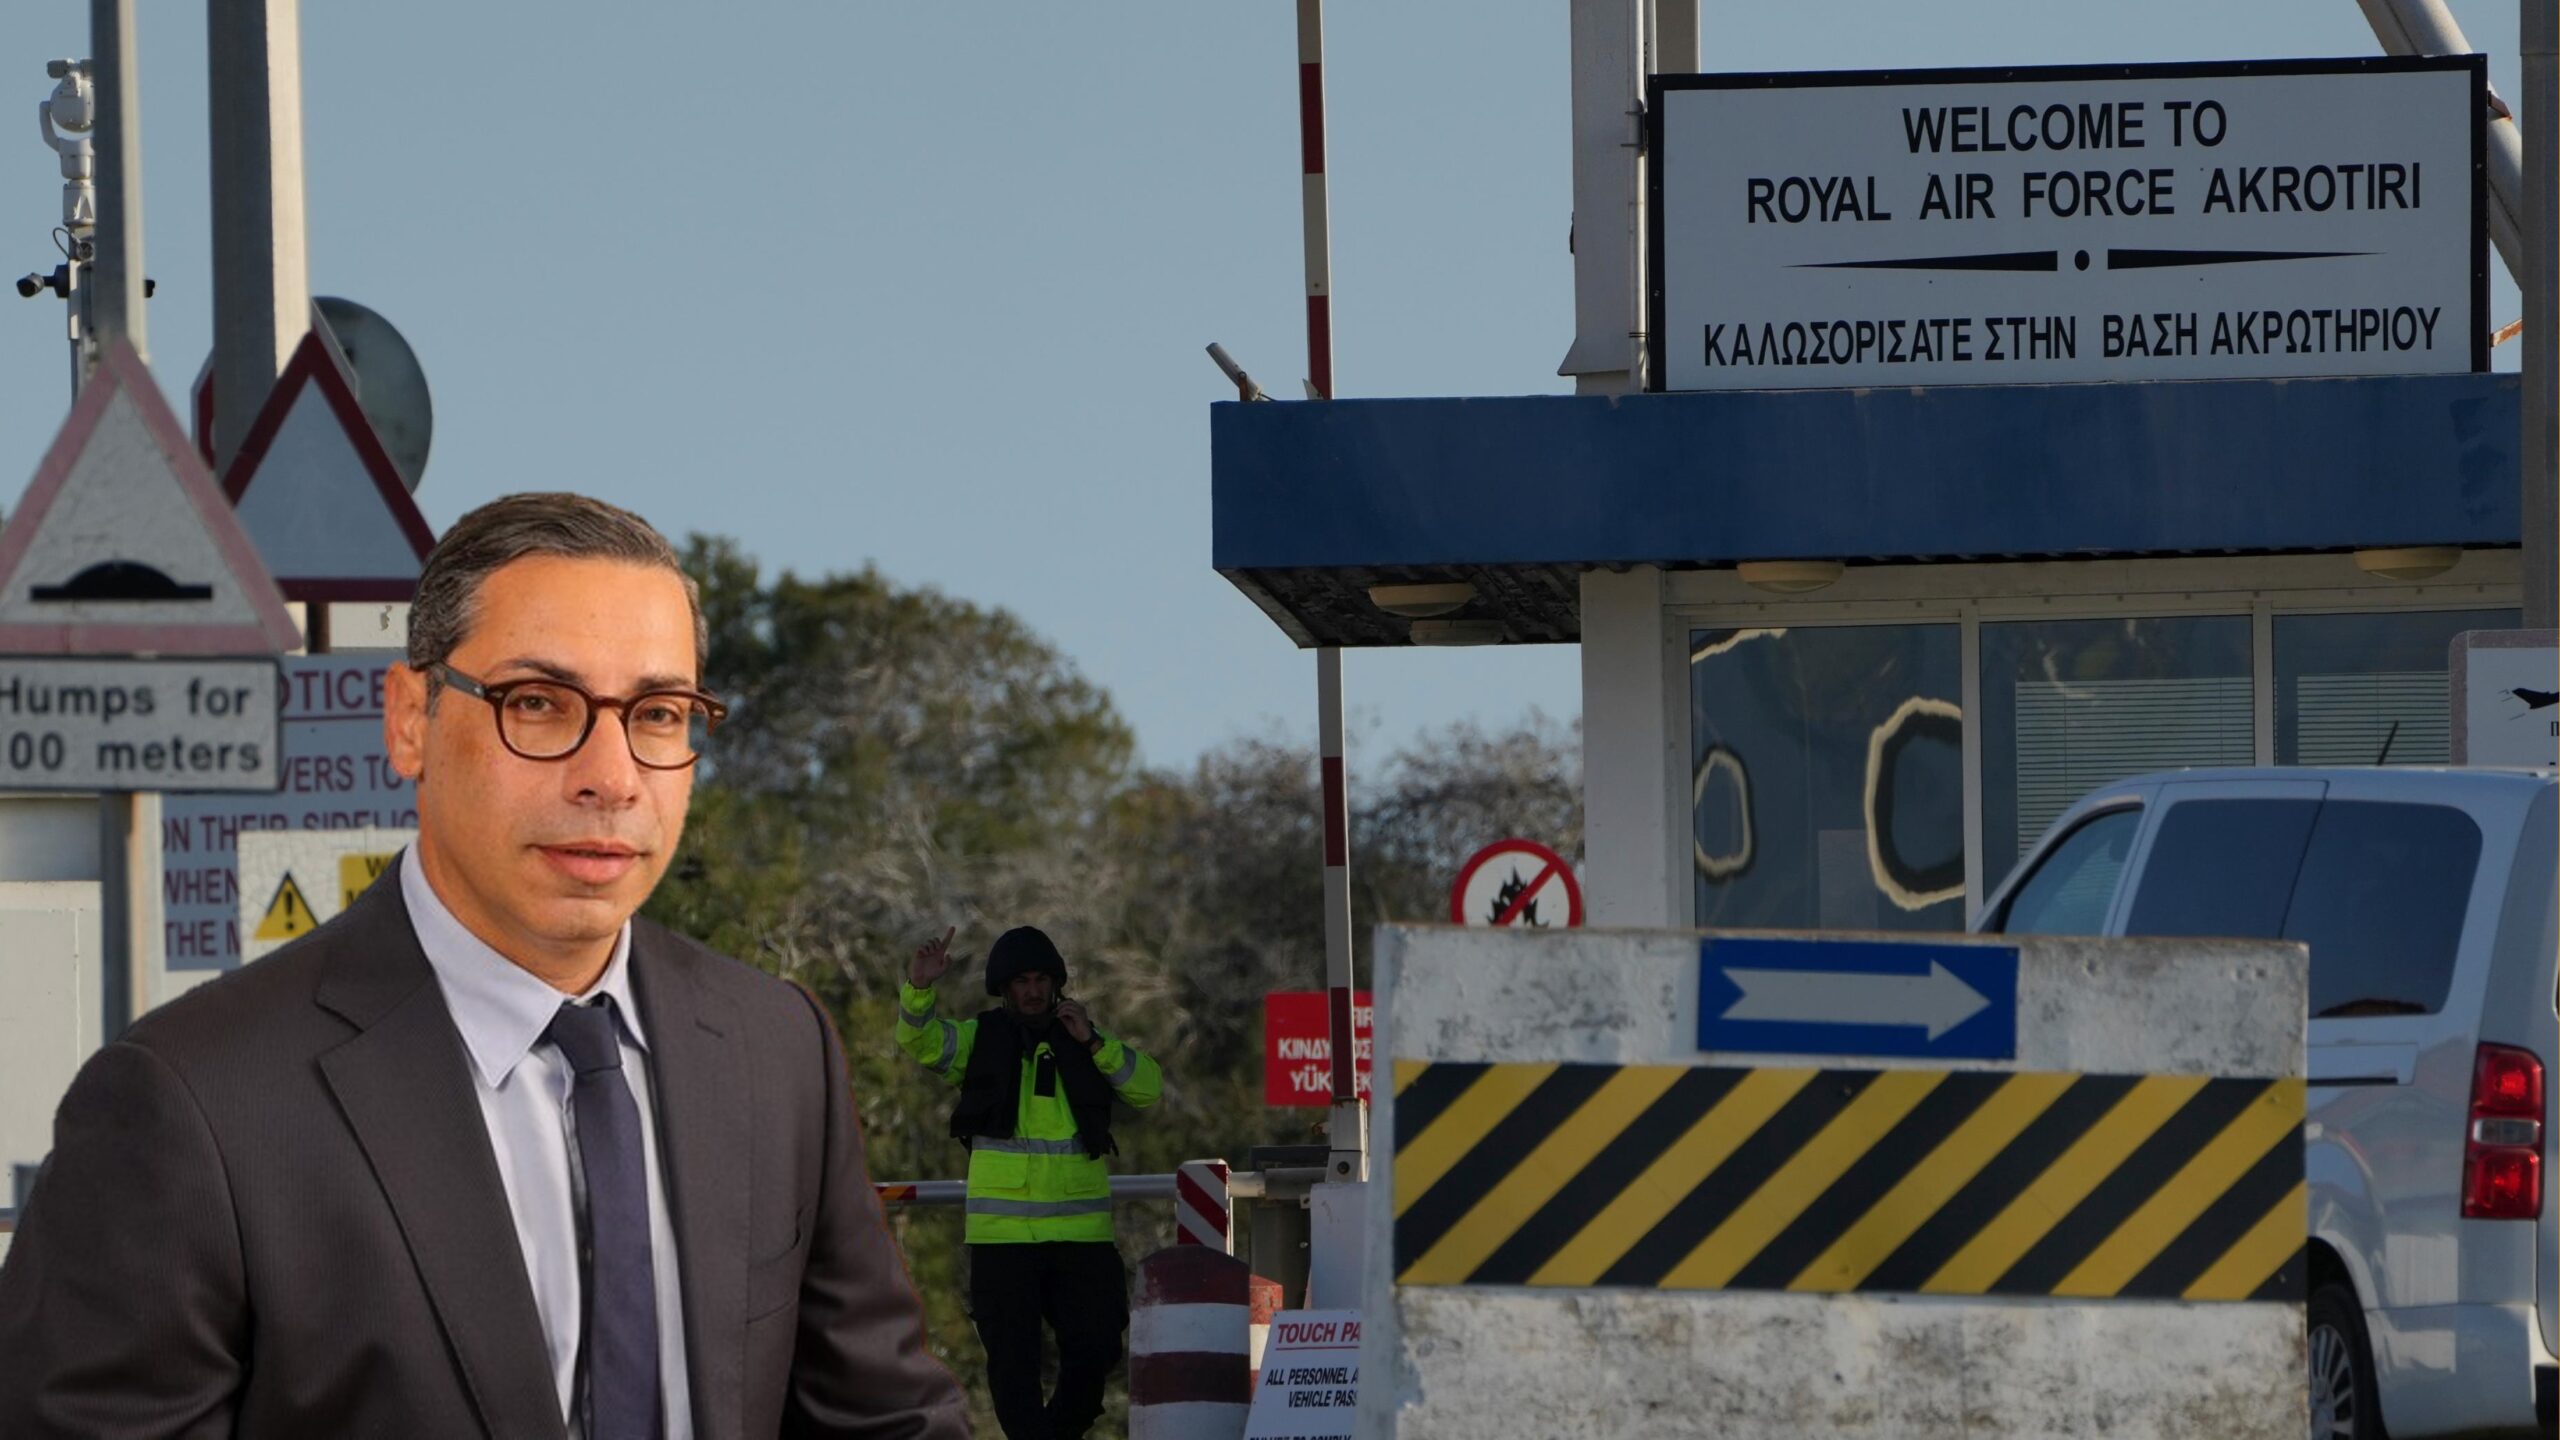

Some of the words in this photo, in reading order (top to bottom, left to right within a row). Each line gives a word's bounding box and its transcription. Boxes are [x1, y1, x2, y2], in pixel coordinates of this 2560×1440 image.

[1901, 101, 2145, 154] WELCOME
[2163, 99, 2227, 147] TO
[1747, 175, 1892, 224] ROYAL
[1919, 173, 1996, 221] AIR
[2023, 168, 2175, 218] FORCE
[2202, 162, 2421, 214] AKROTIRI
[1704, 317, 1973, 367] ΚΑΛΩΣΟΡΙΣΑΤΕ
[1984, 315, 2076, 361] ΣΤΗΝ
[2102, 312, 2198, 358] ΒΑΣΗ
[2210, 305, 2441, 356] ΑΚΡΩΤΗΡΙΟΥ
[0, 674, 156, 724] Humps
[187, 677, 251, 716] for
[97, 737, 262, 772] meters
[163, 817, 191, 852] N
[164, 868, 240, 904] WHEN
[1278, 1037, 1372, 1060] ΚΙΝΔΥΣ
[1289, 1063, 1372, 1092] YÜKK
[1278, 1322, 1337, 1344] TOUCH
[1265, 1369, 1285, 1386] ALL
[1287, 1367, 1348, 1385] PERSONNEL
[1288, 1390, 1332, 1408] VEHICLE
